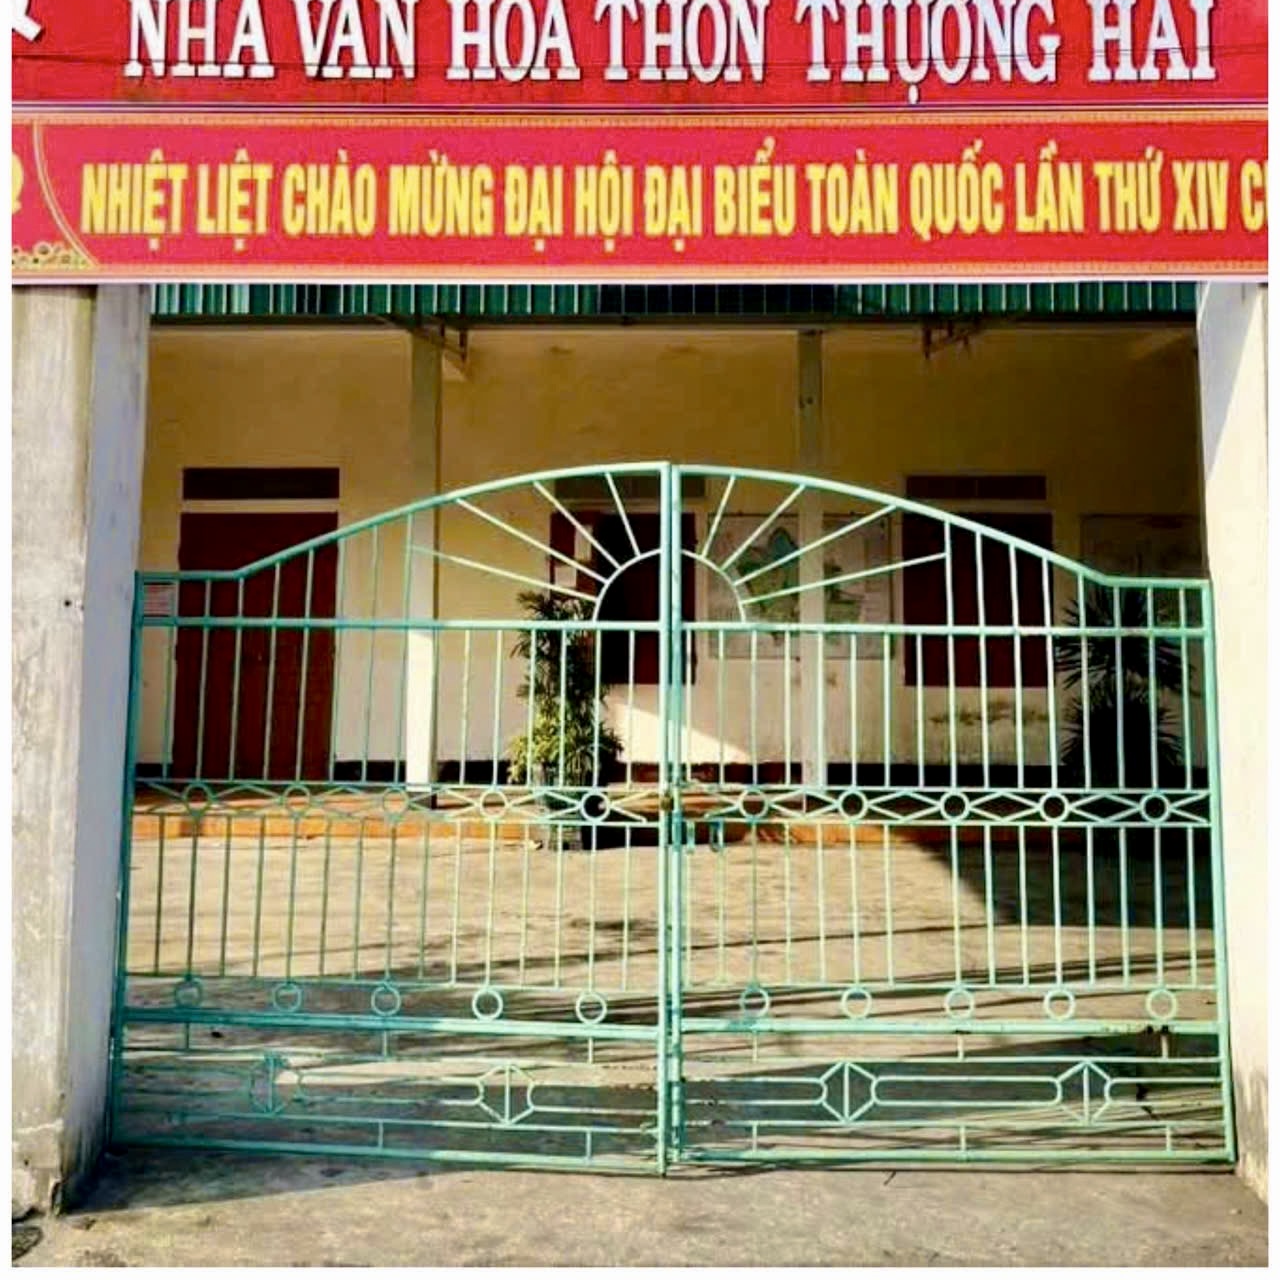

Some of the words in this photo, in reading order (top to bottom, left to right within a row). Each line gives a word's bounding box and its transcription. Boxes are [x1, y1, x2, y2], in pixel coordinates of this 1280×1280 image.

[81, 149, 189, 252] NHIỆT
[197, 149, 275, 252] LIỆT
[283, 149, 377, 236] CHÀO
[389, 150, 494, 236] MỪNG
[505, 165, 563, 252] ĐẠI
[575, 150, 634, 252] HỘI
[645, 165, 702, 251] ĐẠI
[714, 136, 796, 236] BIỂU
[807, 149, 898, 236] TOÀN
[909, 140, 1004, 241] QUỐC
[1015, 140, 1084, 234] LẦN
[1093, 146, 1164, 233] THỨ
[1173, 161, 1229, 232] XIV
[1240, 161, 1269, 232] C
